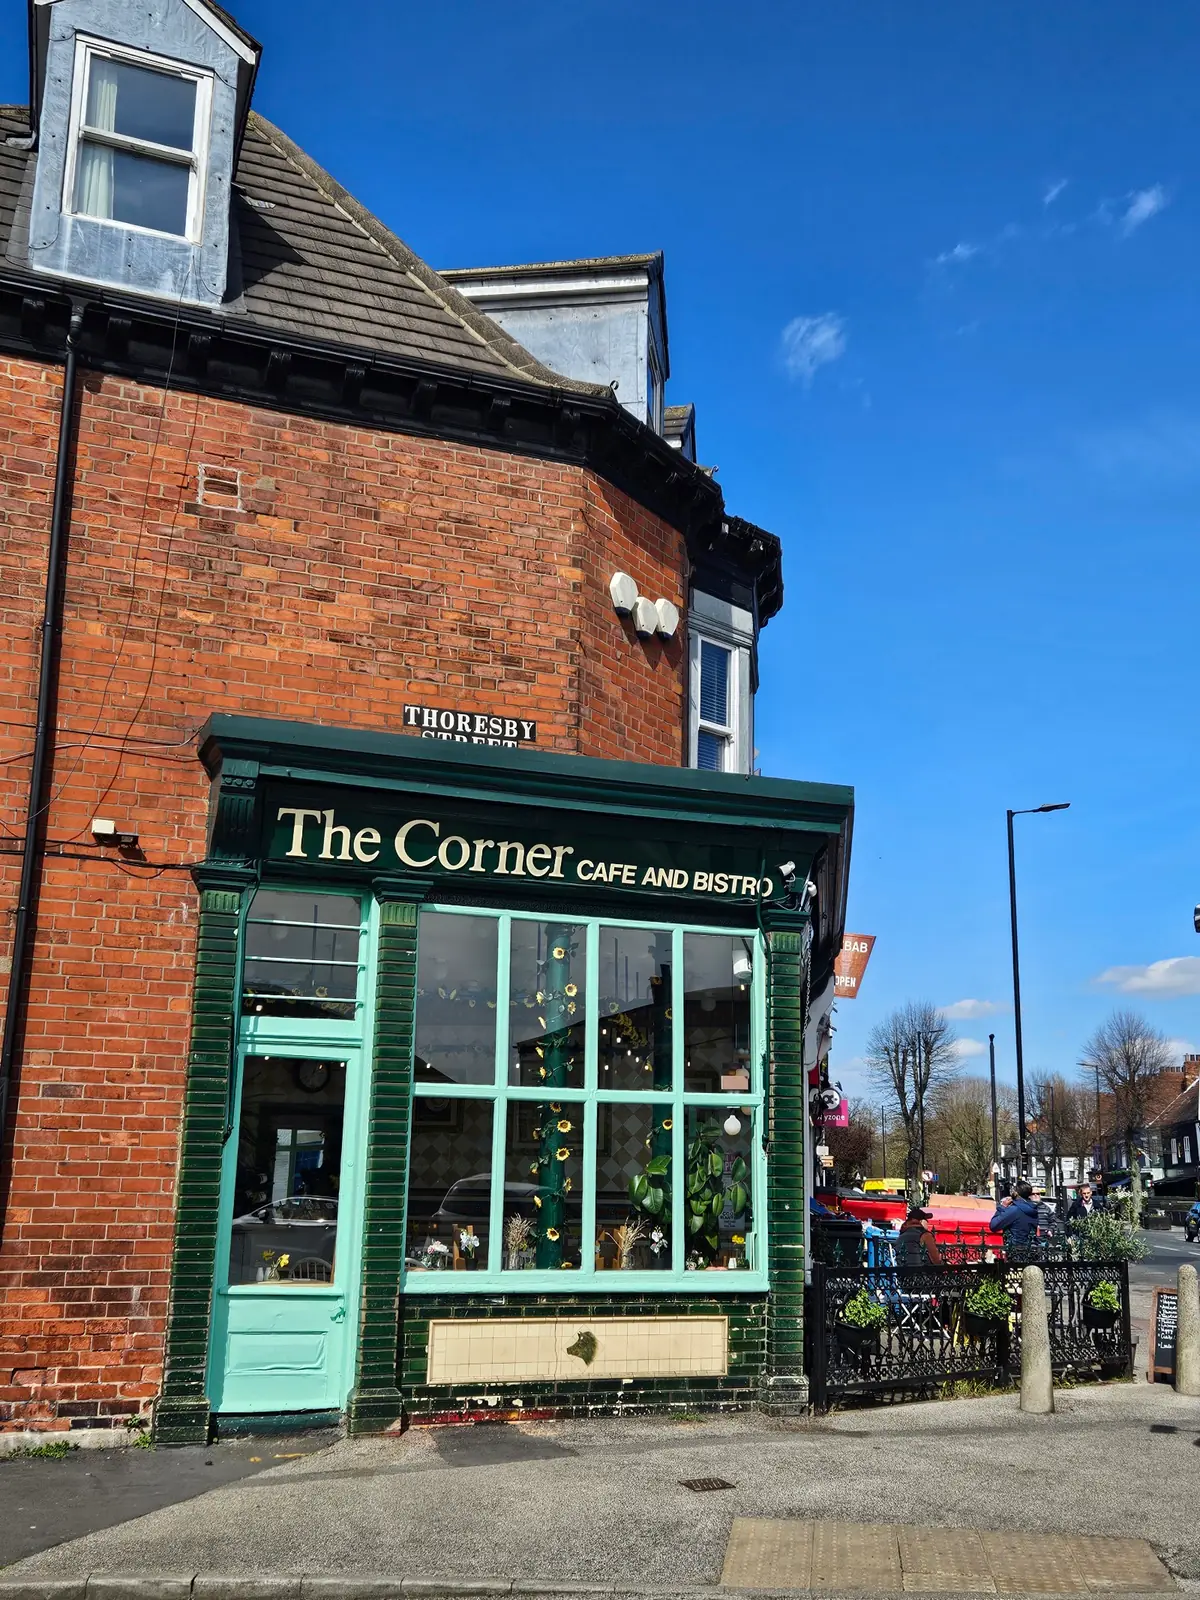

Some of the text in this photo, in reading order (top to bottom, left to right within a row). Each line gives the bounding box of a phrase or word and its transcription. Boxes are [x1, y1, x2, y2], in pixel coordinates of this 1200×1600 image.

[404, 705, 535, 739] THORESBY
[277, 807, 774, 897] The Corner CAFE AND BISTRO
[843, 940, 868, 953] BAB
